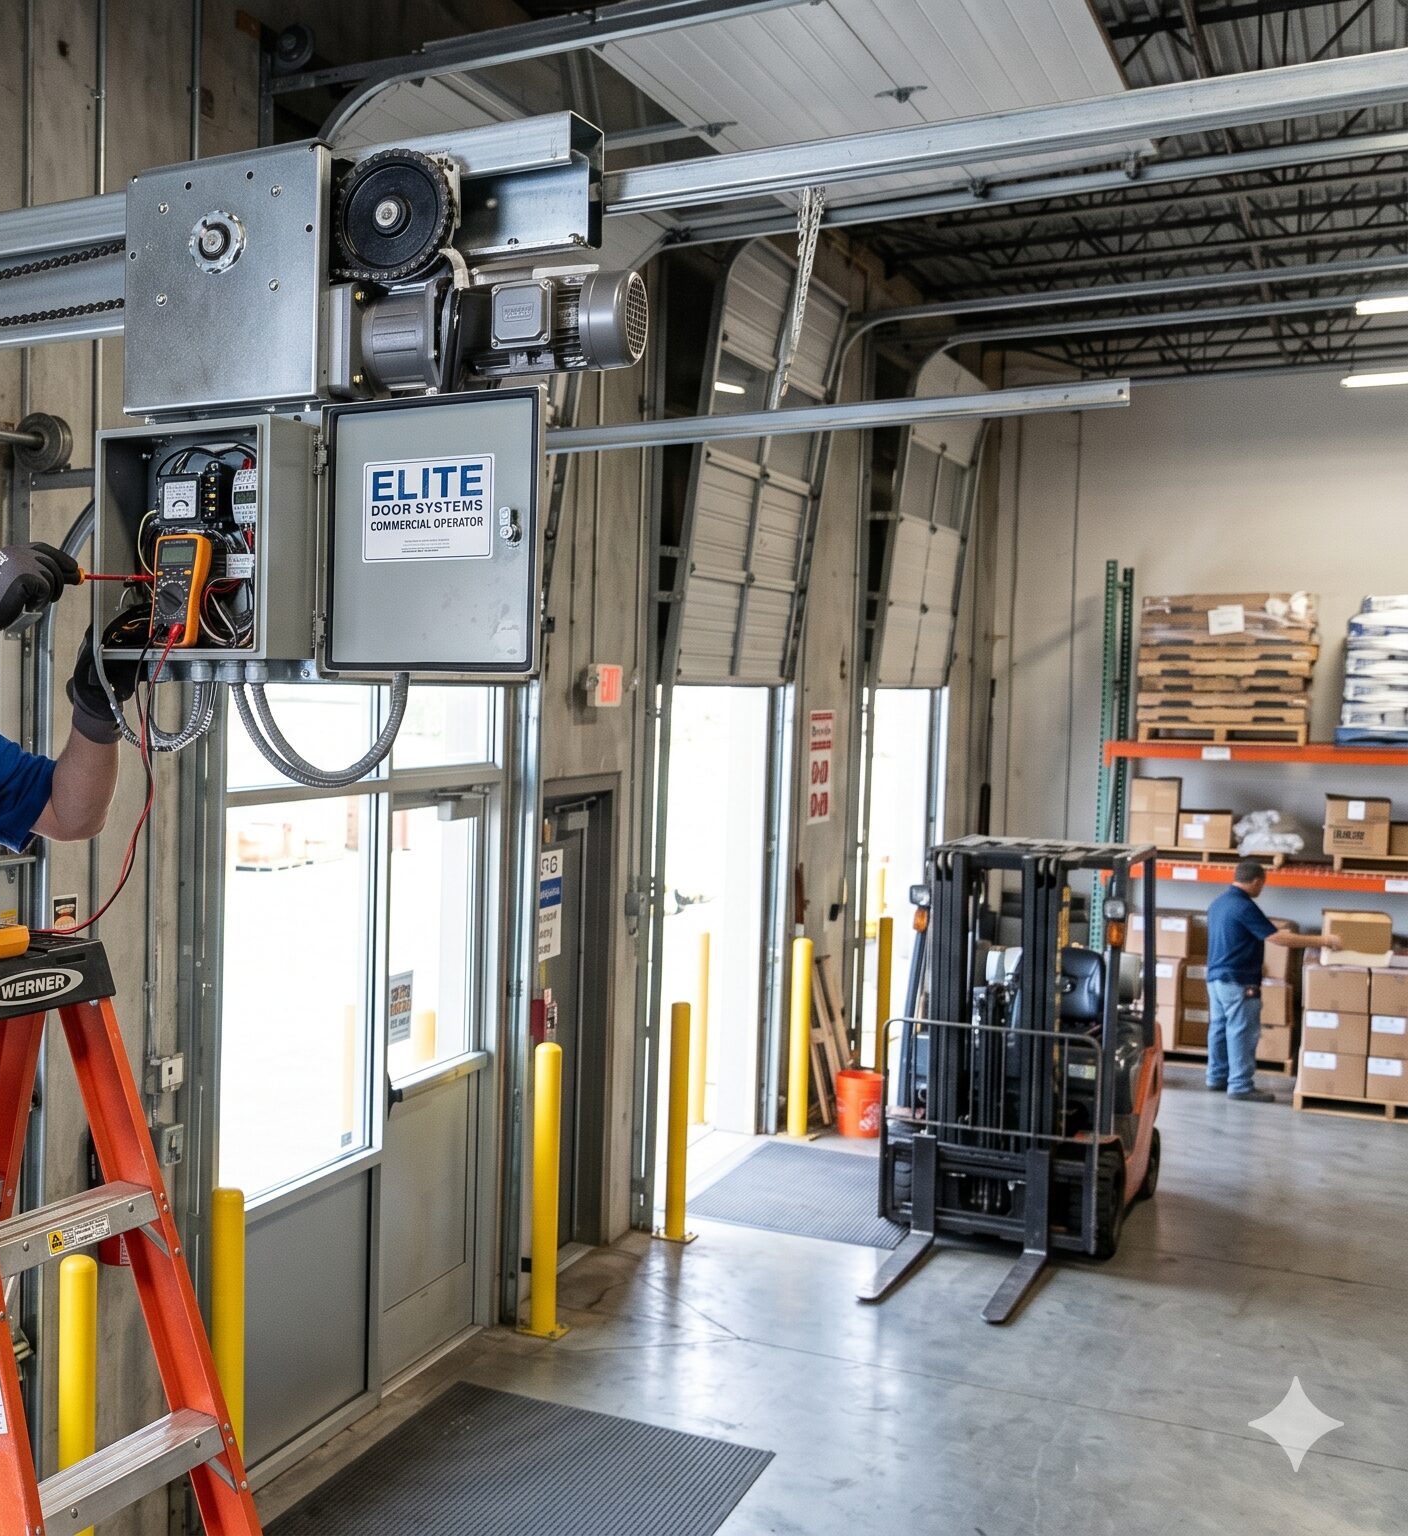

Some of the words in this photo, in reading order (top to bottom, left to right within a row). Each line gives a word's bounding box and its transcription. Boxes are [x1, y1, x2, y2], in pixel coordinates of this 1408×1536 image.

[372, 464, 483, 502] ELITE
[372, 503, 411, 516] DOOR
[415, 499, 483, 514] SYSTEMS
[370, 519, 431, 531] COMMERCIAL
[433, 516, 484, 529] OPERATOR
[1, 974, 65, 1000] WERNER
